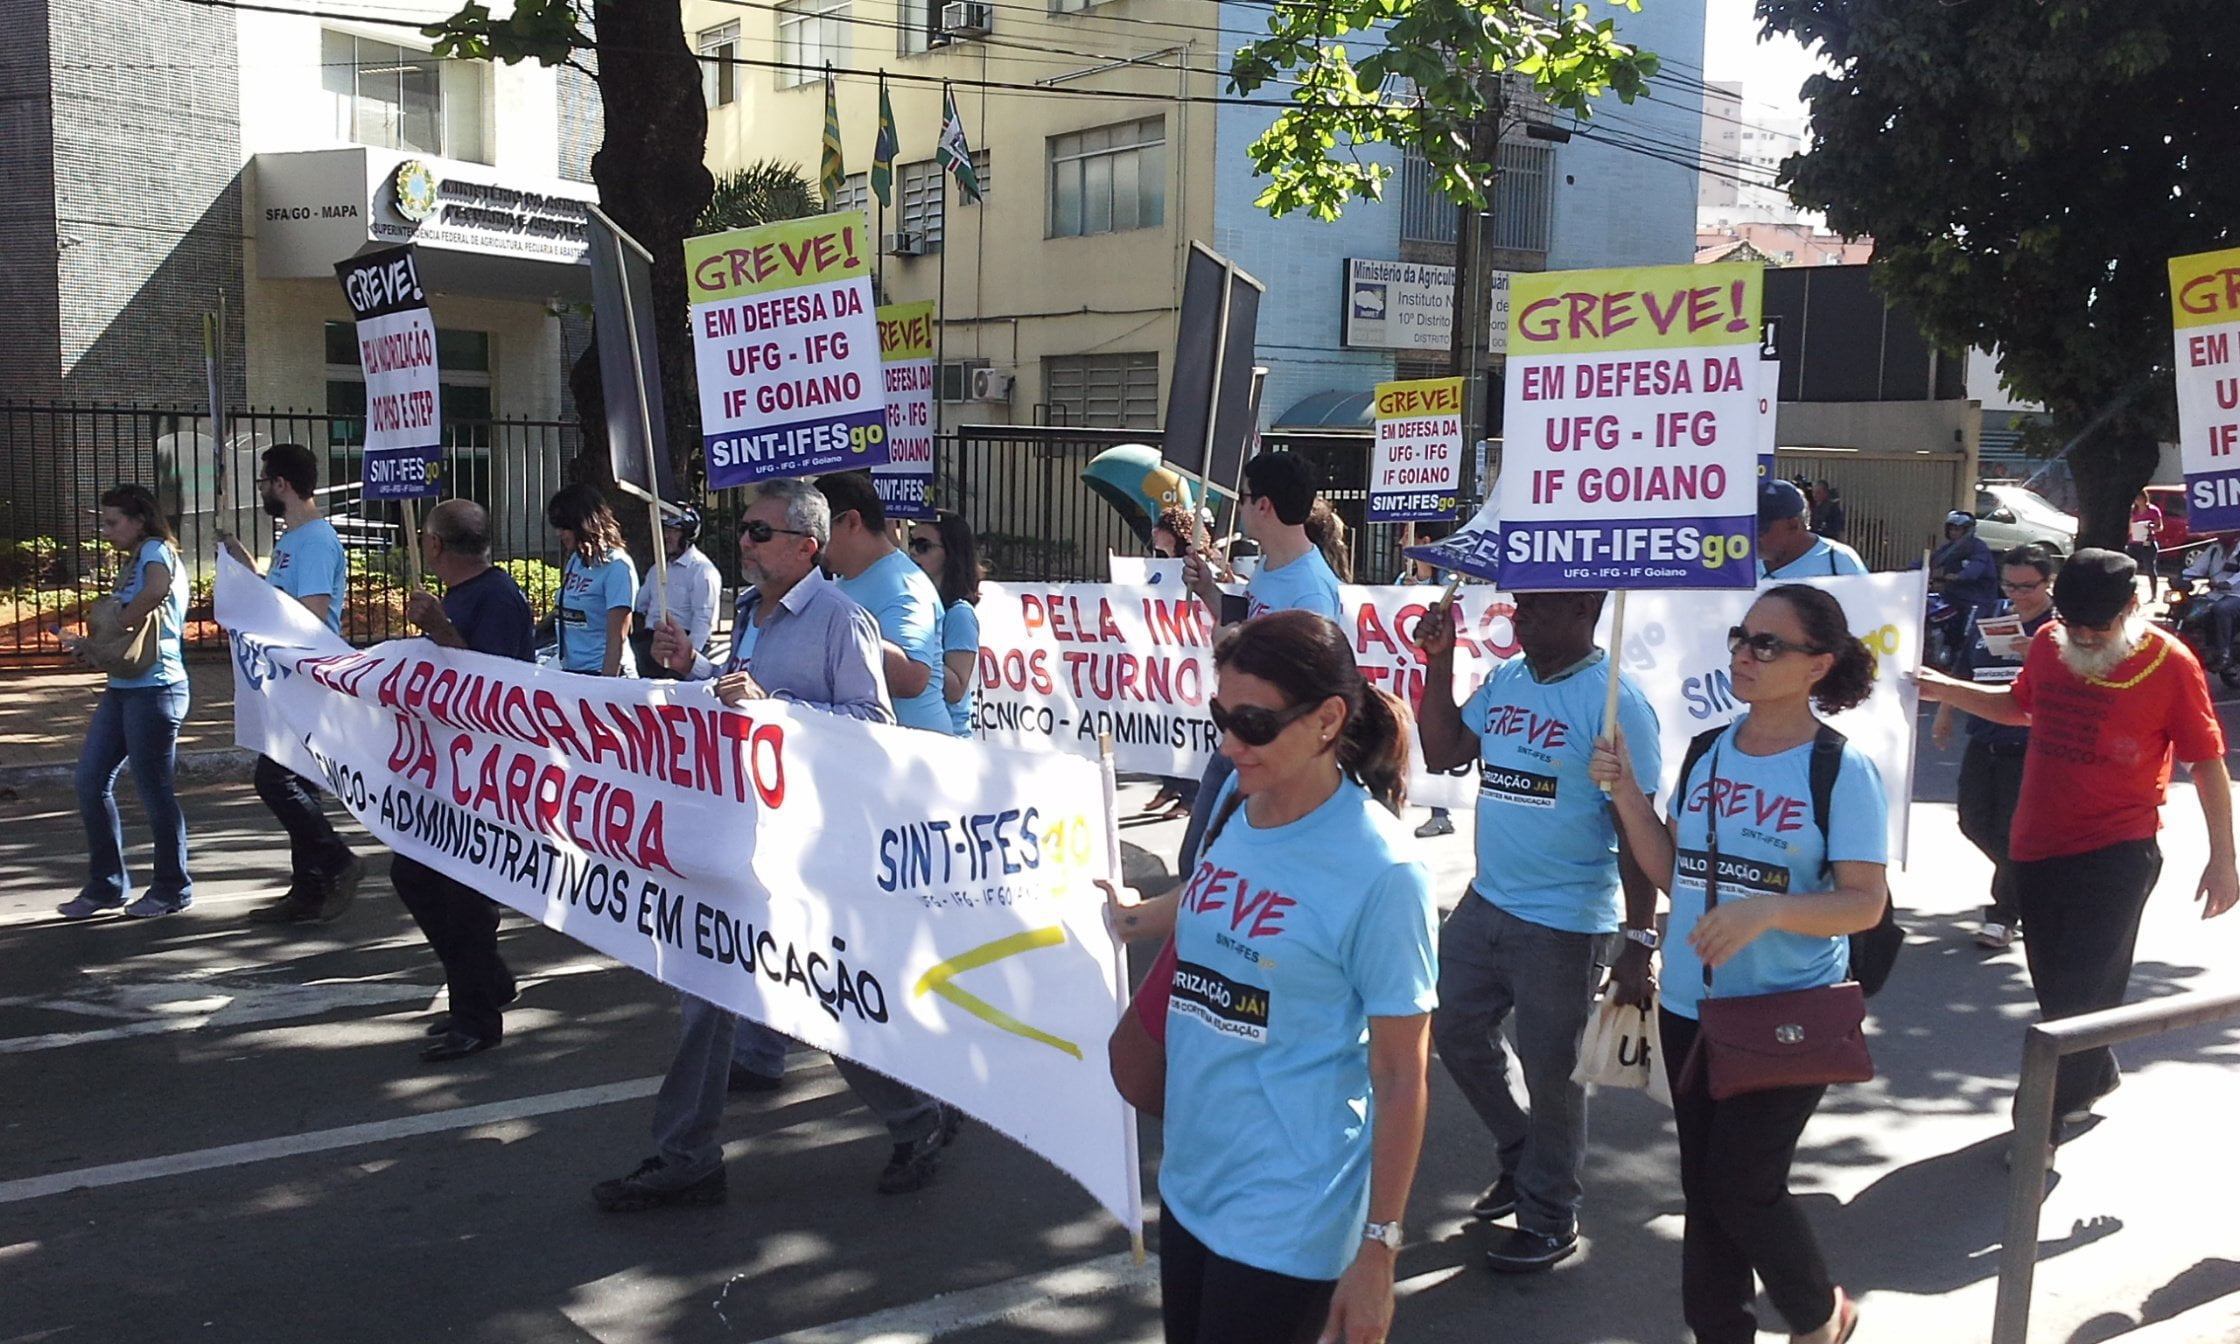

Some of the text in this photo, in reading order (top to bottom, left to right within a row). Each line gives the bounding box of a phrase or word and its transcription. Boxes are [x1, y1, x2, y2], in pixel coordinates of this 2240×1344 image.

[265, 207, 310, 221] SFA/GO
[321, 205, 358, 218] MAPA
[442, 231, 469, 245] FEDERAL
[470, 234, 480, 246] DE
[695, 227, 861, 291] GREVE!
[1354, 260, 1400, 283] Ministério
[1403, 266, 1415, 283] da
[1418, 266, 1455, 289] Agricult
[347, 254, 424, 312] GREVE!
[1398, 291, 1443, 308] Instituto
[2179, 267, 2240, 315] GR
[704, 287, 863, 339] EM DEFESA DA
[1417, 313, 1451, 327] Distrito
[1518, 279, 1750, 342] GREVE!
[877, 312, 933, 352] REVE!
[1414, 333, 1449, 344] DISTRITO
[2189, 333, 2229, 368] EM
[727, 342, 781, 377] UFG
[805, 332, 850, 365] IFG
[723, 372, 861, 419] IF GOIANO
[885, 365, 932, 393] DEFESA DA
[1522, 357, 1743, 401] EM DEFESA DA
[2216, 378, 2238, 410] U
[410, 390, 433, 428] STEP
[885, 404, 901, 427] FG
[909, 402, 927, 426] IFG
[1378, 386, 1459, 414] GREVE!
[712, 422, 884, 468] SINT-IFESgo
[890, 437, 931, 462] GOIANO
[1381, 419, 1458, 440] EM DEFESA DA
[1546, 414, 1620, 452] UFG
[1656, 410, 1716, 448] IFG
[2209, 424, 2238, 457] IF
[755, 464, 775, 474] UFG
[780, 461, 796, 471] IFG
[812, 456, 842, 466] Goiano
[1389, 445, 1413, 462] UFG
[1424, 444, 1447, 460] IFG
[1162, 486, 1178, 502] oi
[1383, 466, 1450, 485] IF GOIANO
[1532, 464, 1727, 504] IF GOIANO
[1506, 526, 1749, 569] SINT-IFESgo
[1564, 568, 1589, 579] UFG
[1600, 567, 1620, 578] IFG
[1630, 567, 1642, 578] IF
[1644, 567, 1687, 578] Goiano
[1021, 594, 1126, 643] PELA
[1141, 597, 1216, 648] IMP
[1357, 593, 1522, 666] AÇÃO
[980, 645, 1212, 706] DOS TURNO
[378, 657, 784, 809] APRIMORAMENTO
[1484, 704, 1569, 749] GREVE
[387, 712, 688, 880] DA CARREIRA
[1687, 776, 1809, 833] GREVE
[1677, 855, 1761, 881] VALOZAÇÃO
[1181, 860, 1298, 939] REVE
[637, 880, 683, 949] EM
[695, 901, 888, 1024] EDUCAÇÃO
[1172, 970, 1267, 1017] RIZAÇÃO JÁ!
